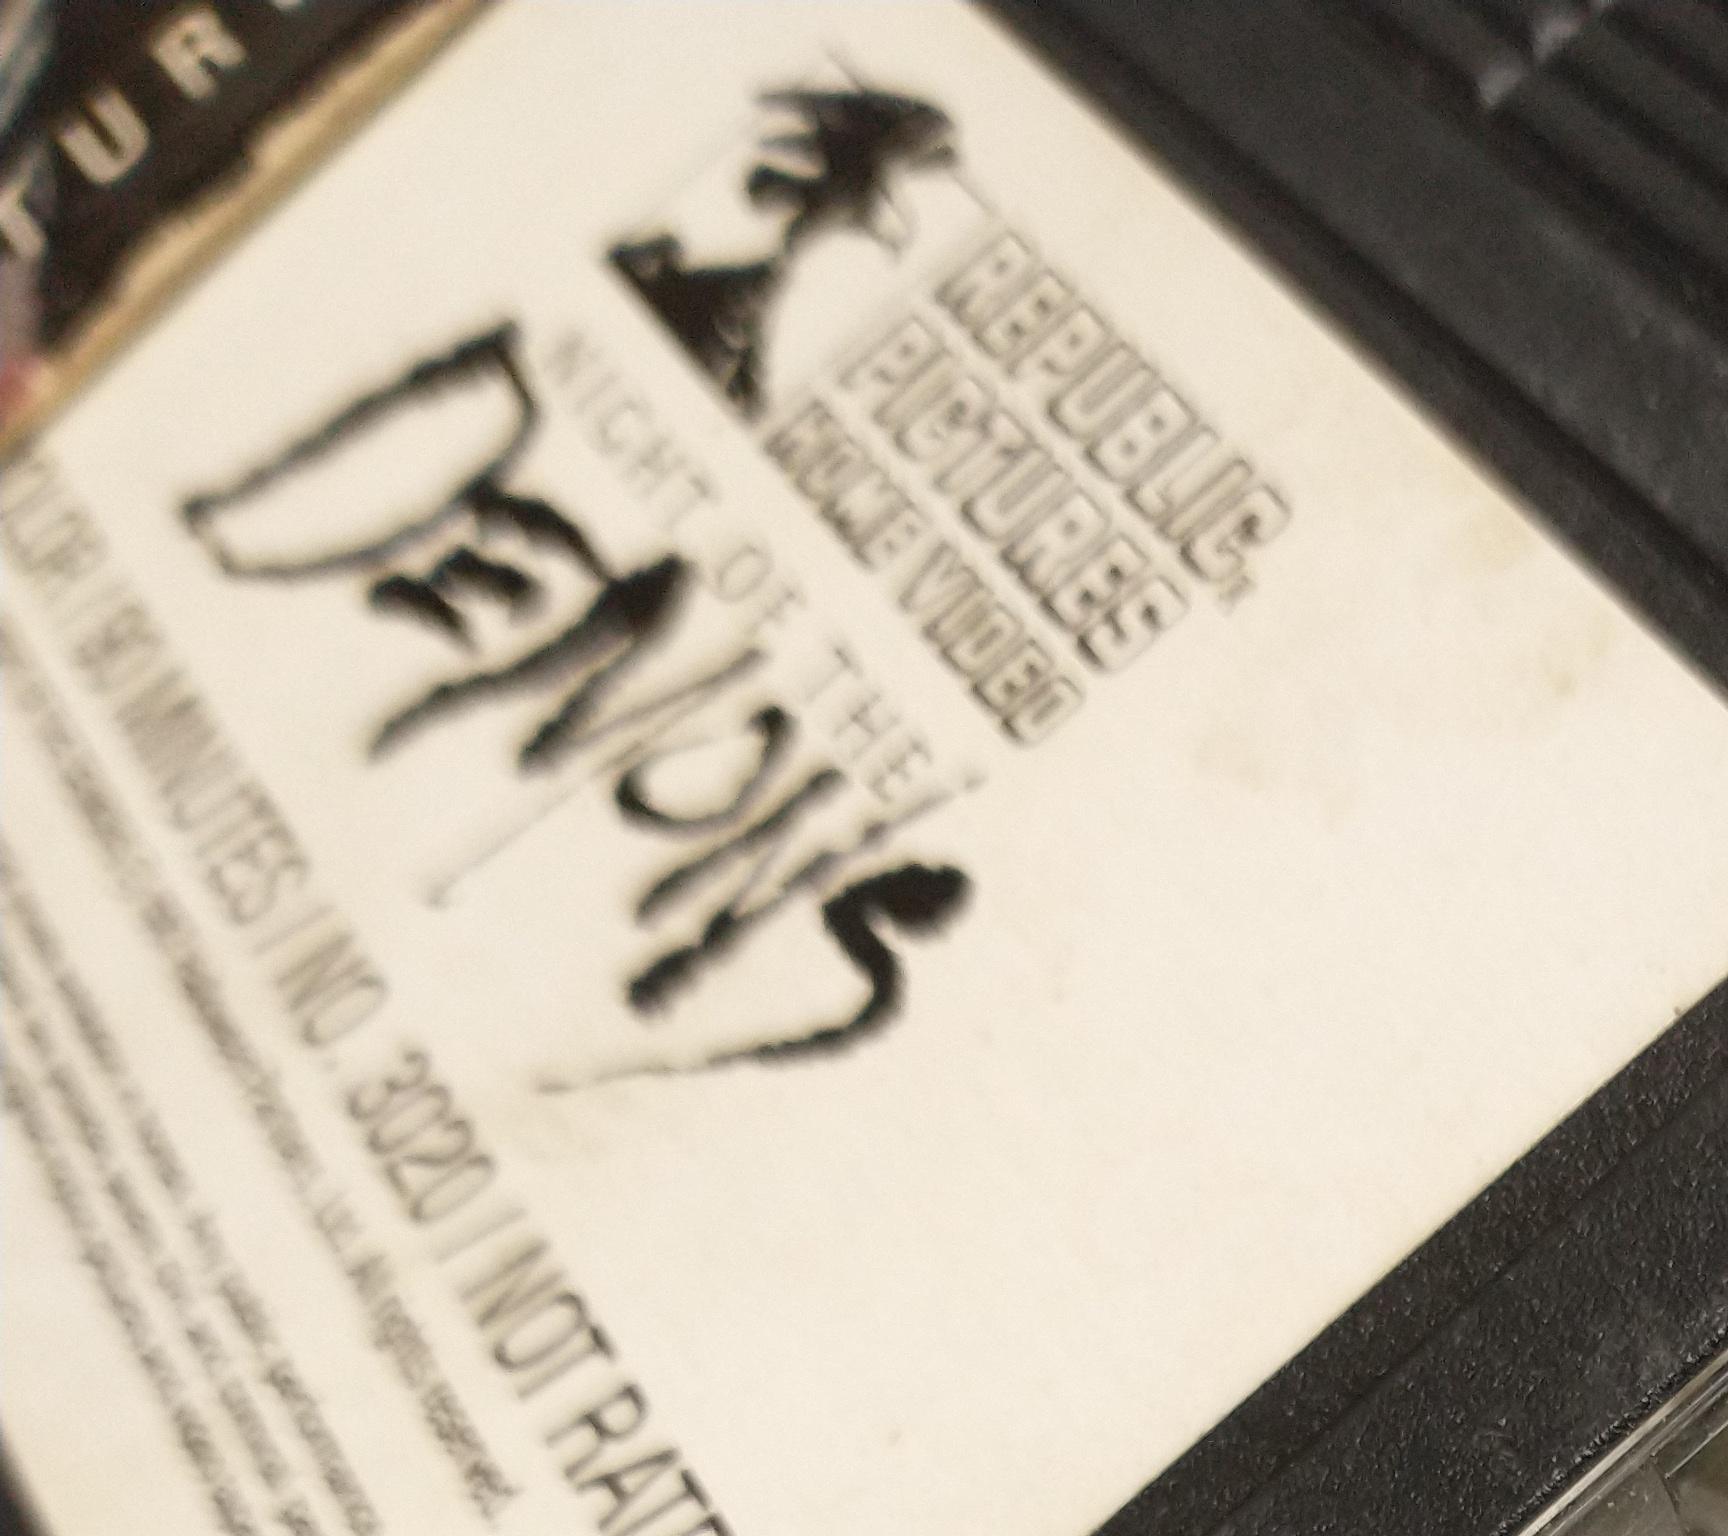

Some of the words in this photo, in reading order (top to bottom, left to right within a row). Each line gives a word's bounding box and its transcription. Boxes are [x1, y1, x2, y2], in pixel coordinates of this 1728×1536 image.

[543, 330, 719, 528] NIGHT
[716, 543, 808, 634] OF
[806, 636, 935, 802] THE
[763, 398, 932, 573] HOME
[899, 537, 1086, 748] VIDEO
[836, 315, 1189, 674] PICTURES
[935, 229, 1292, 583] REPUBLIC
[113, 664, 312, 928] MINUTES
[277, 932, 389, 1072] NO.
[347, 1047, 498, 1225] 3020
[461, 1238, 616, 1400] NOT
